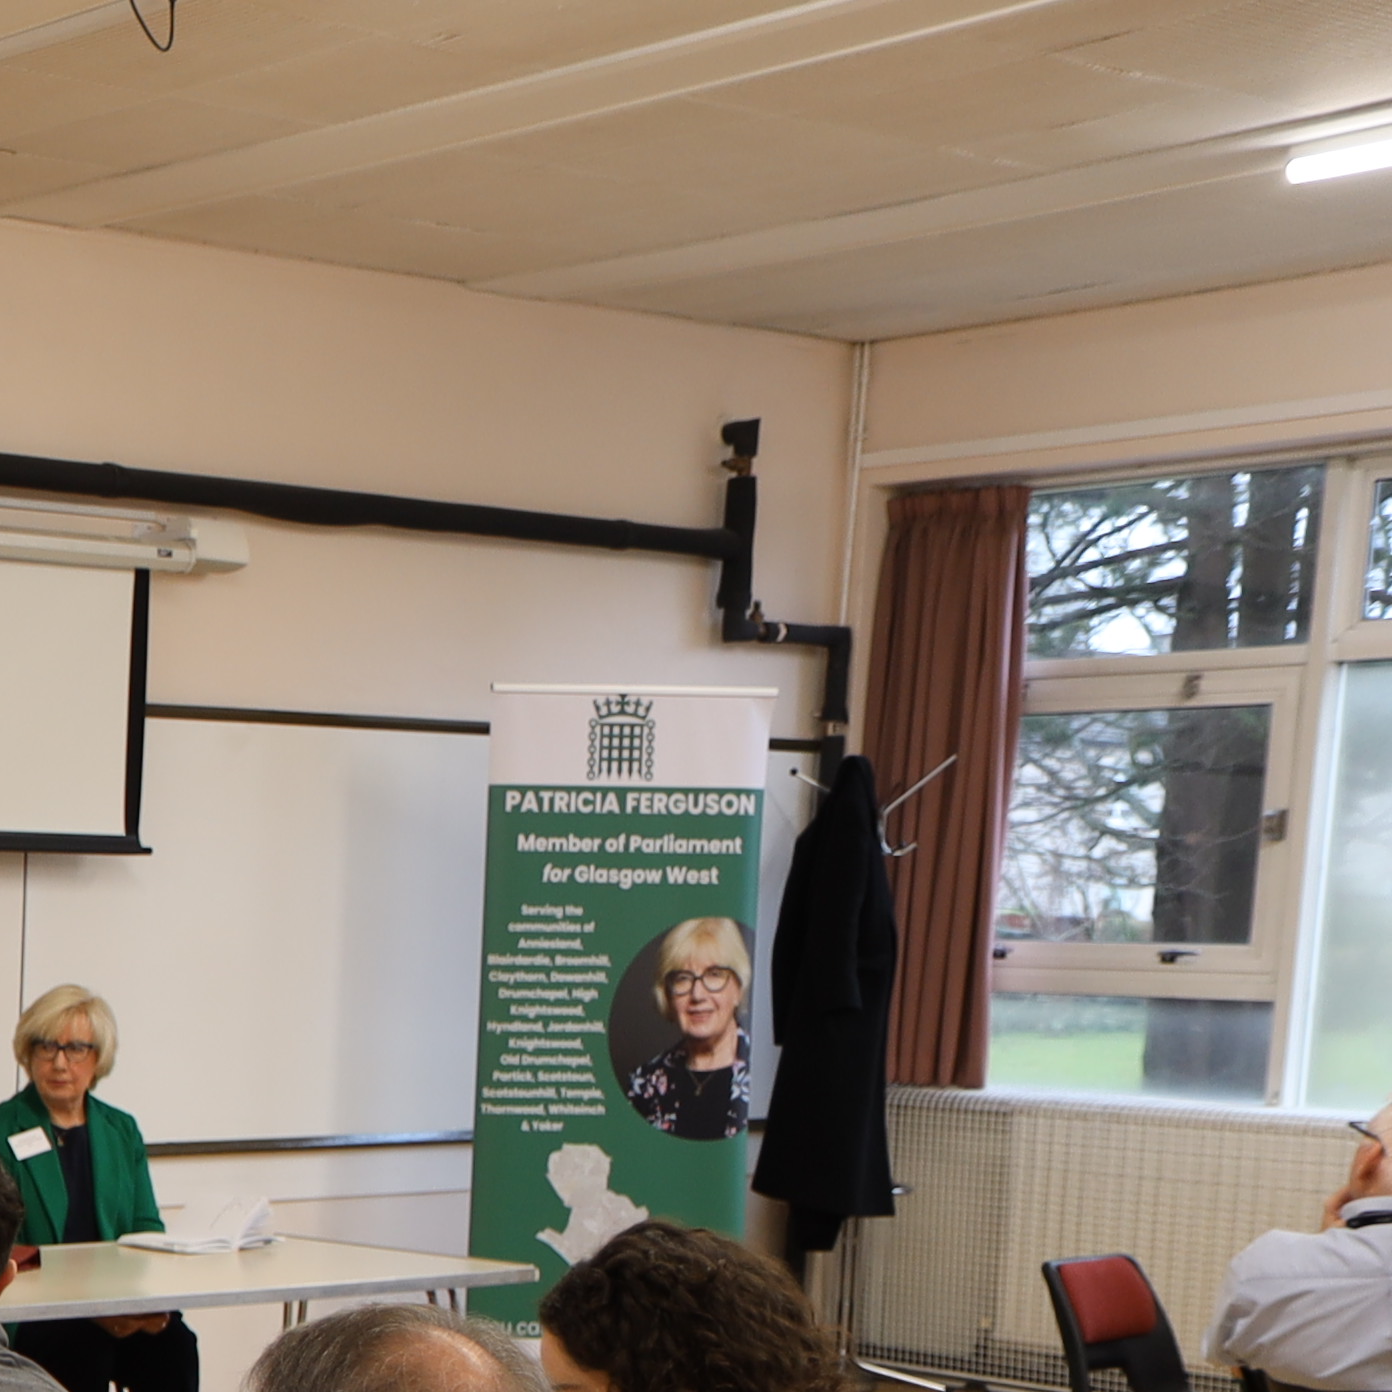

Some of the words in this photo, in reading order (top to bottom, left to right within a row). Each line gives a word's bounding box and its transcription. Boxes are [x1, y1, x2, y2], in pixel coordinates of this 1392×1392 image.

[505, 790, 620, 814] PATRICIA
[625, 792, 756, 816] FERGUSON
[517, 832, 602, 853] Member
[605, 834, 625, 853] of
[628, 834, 742, 855] Parliament
[542, 863, 572, 883] for
[574, 865, 663, 890] Glasgow
[666, 867, 719, 885] West
[520, 904, 564, 919] Serving
[565, 904, 584, 917] the
[507, 921, 582, 933] communities
[583, 921, 595, 933] of
[516, 1321, 544, 1337] ca
